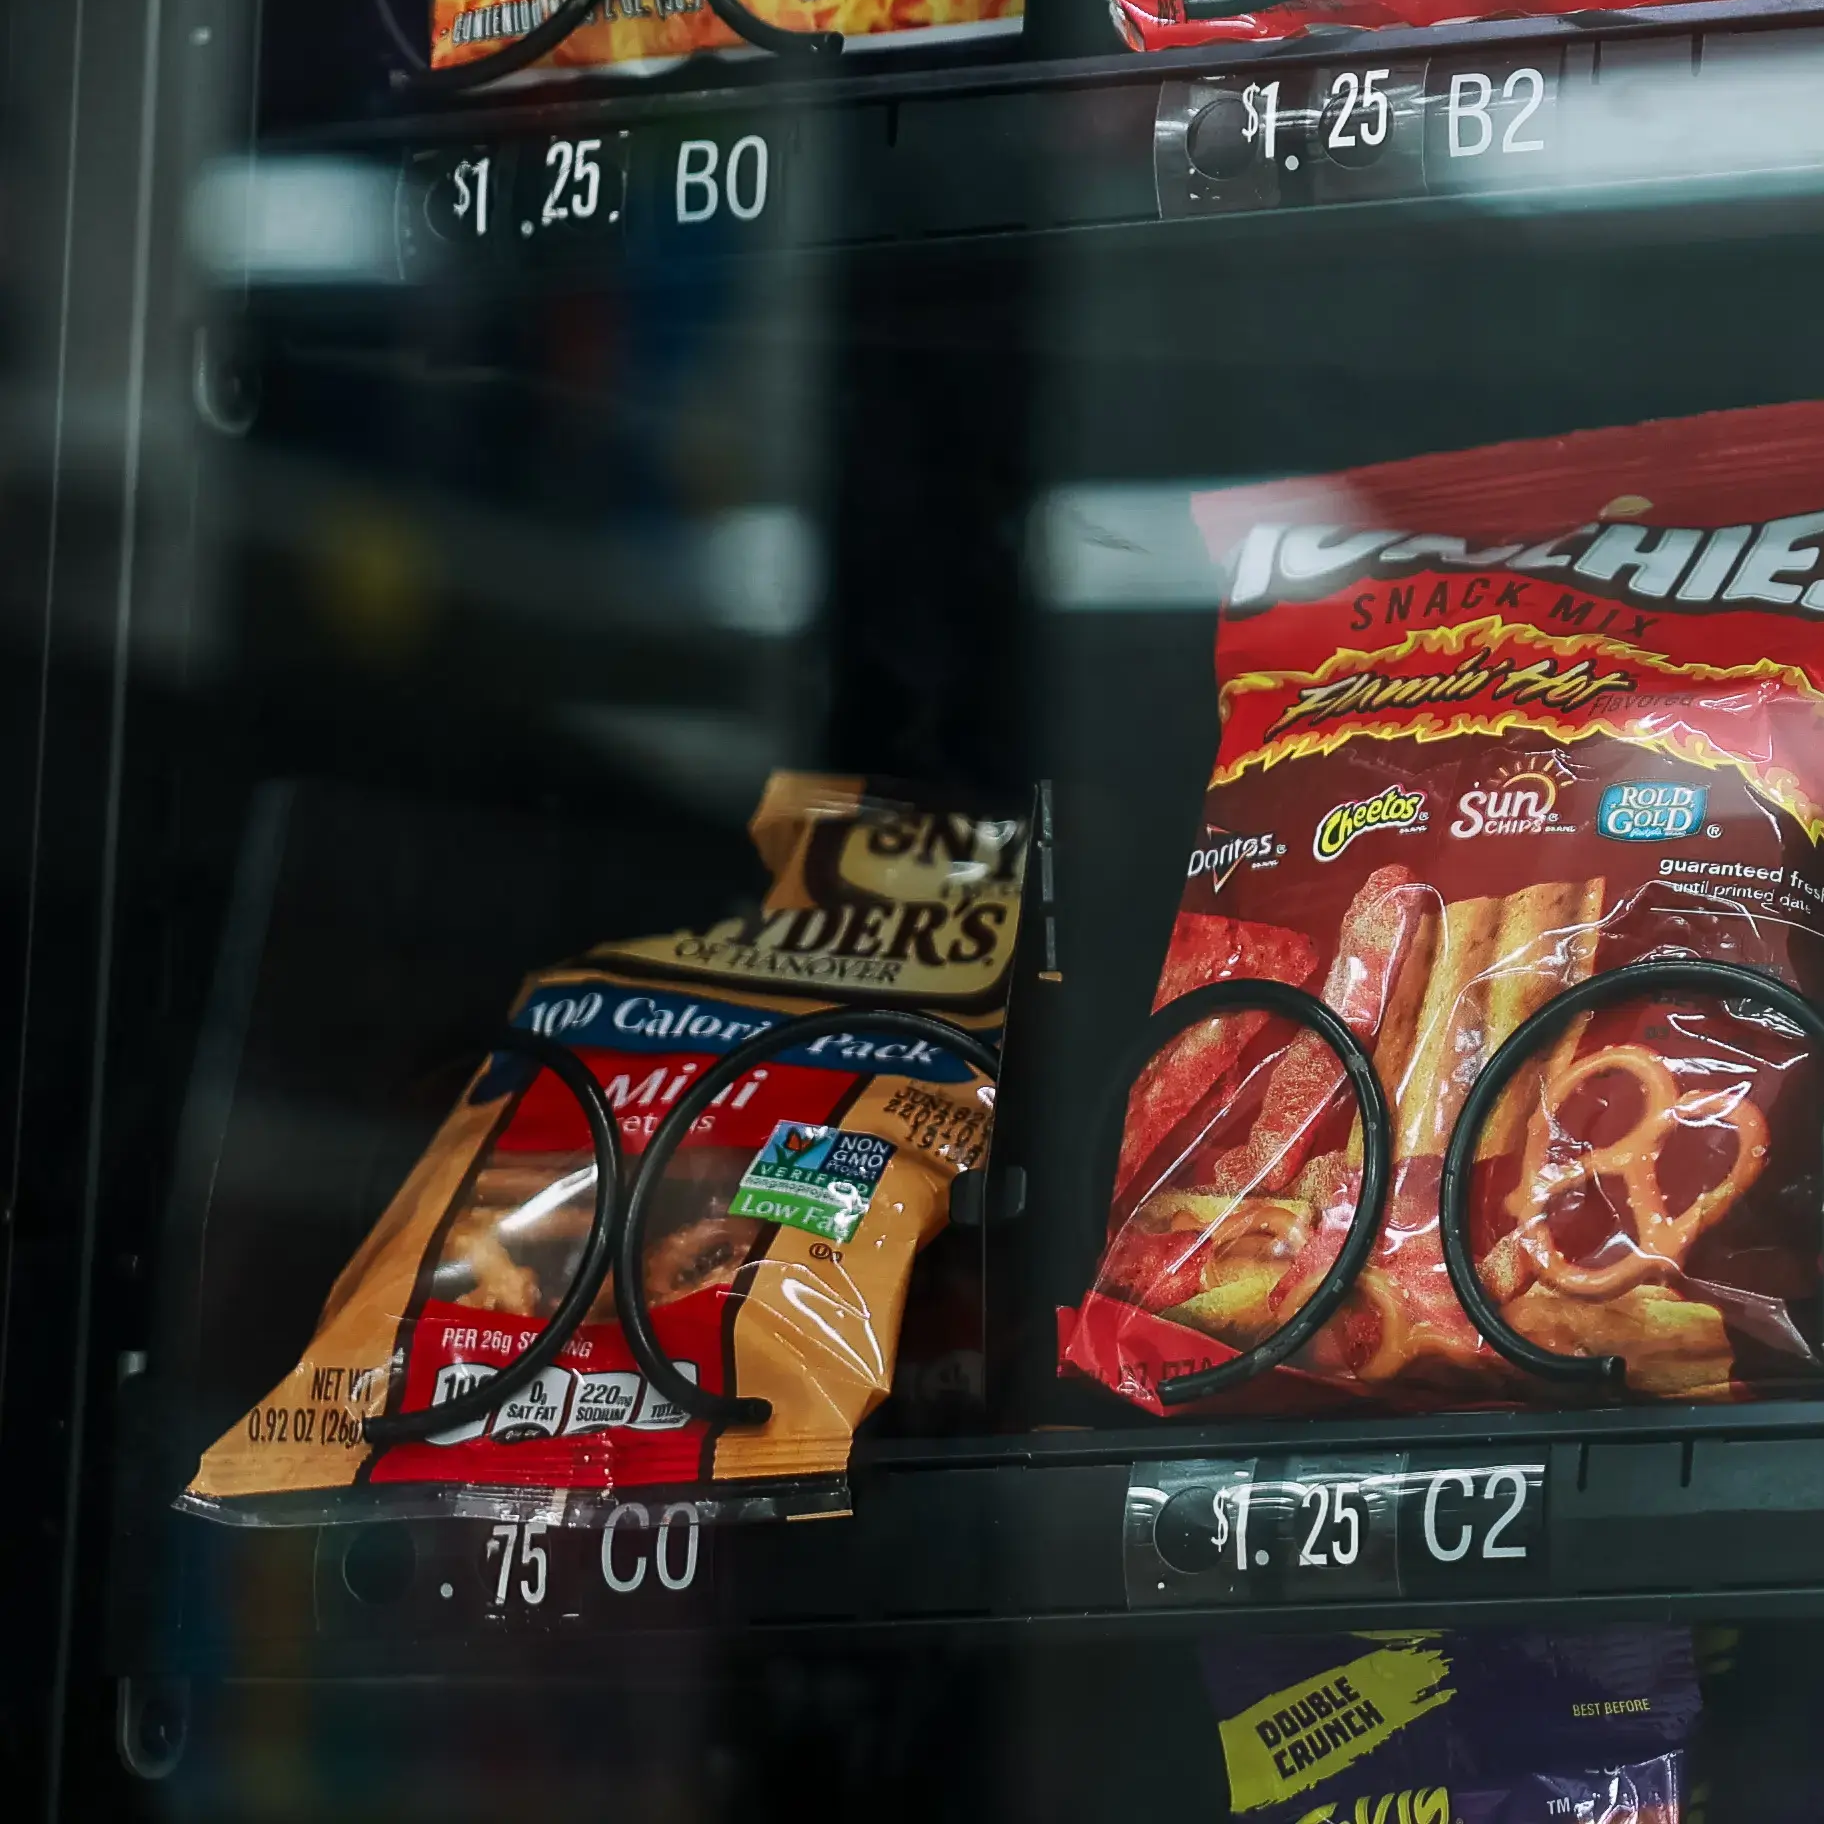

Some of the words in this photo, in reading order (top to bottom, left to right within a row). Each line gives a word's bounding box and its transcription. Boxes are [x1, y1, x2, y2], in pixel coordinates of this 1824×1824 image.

[1448, 67, 1547, 160] B2
[675, 135, 770, 225] B0
[1349, 577, 1527, 632] SNACK
[1547, 592, 1660, 641] MIX
[1497, 654, 1638, 706] Hot
[1450, 781, 1549, 839] Sun
[1619, 786, 1691, 809] ROLD
[1321, 789, 1422, 850] Cheetos
[1483, 819, 1543, 835] CHIPS
[1606, 804, 1693, 833] GOLD
[1187, 831, 1271, 876] Doritos
[1659, 858, 1784, 884] guaranteed
[1673, 880, 1709, 894] until
[1713, 885, 1775, 902] printed
[674, 937, 716, 958] OF
[733, 948, 904, 984] HANOVER
[527, 993, 604, 1038] 100
[807, 1033, 943, 1064] Pack
[832, 1149, 884, 1168] GMO
[840, 1136, 891, 1154] NON
[440, 1328, 478, 1350] PER
[480, 1330, 512, 1353] 26g
[310, 1367, 346, 1402] NET
[248, 1409, 287, 1443] 0.92
[292, 1408, 316, 1440] OZ
[506, 1404, 532, 1421] SAT
[534, 1405, 557, 1423] FAT
[575, 1406, 627, 1423] SODIUM
[1420, 1465, 1529, 1562] C2
[600, 1501, 701, 1594] C0
[1254, 1673, 1360, 1751] DOUBLE
[1571, 1701, 1601, 1717] BEST
[1603, 1697, 1652, 1715] BEFORE
[1271, 1697, 1386, 1780] CRUNCH
[1545, 1796, 1572, 1815] TM
